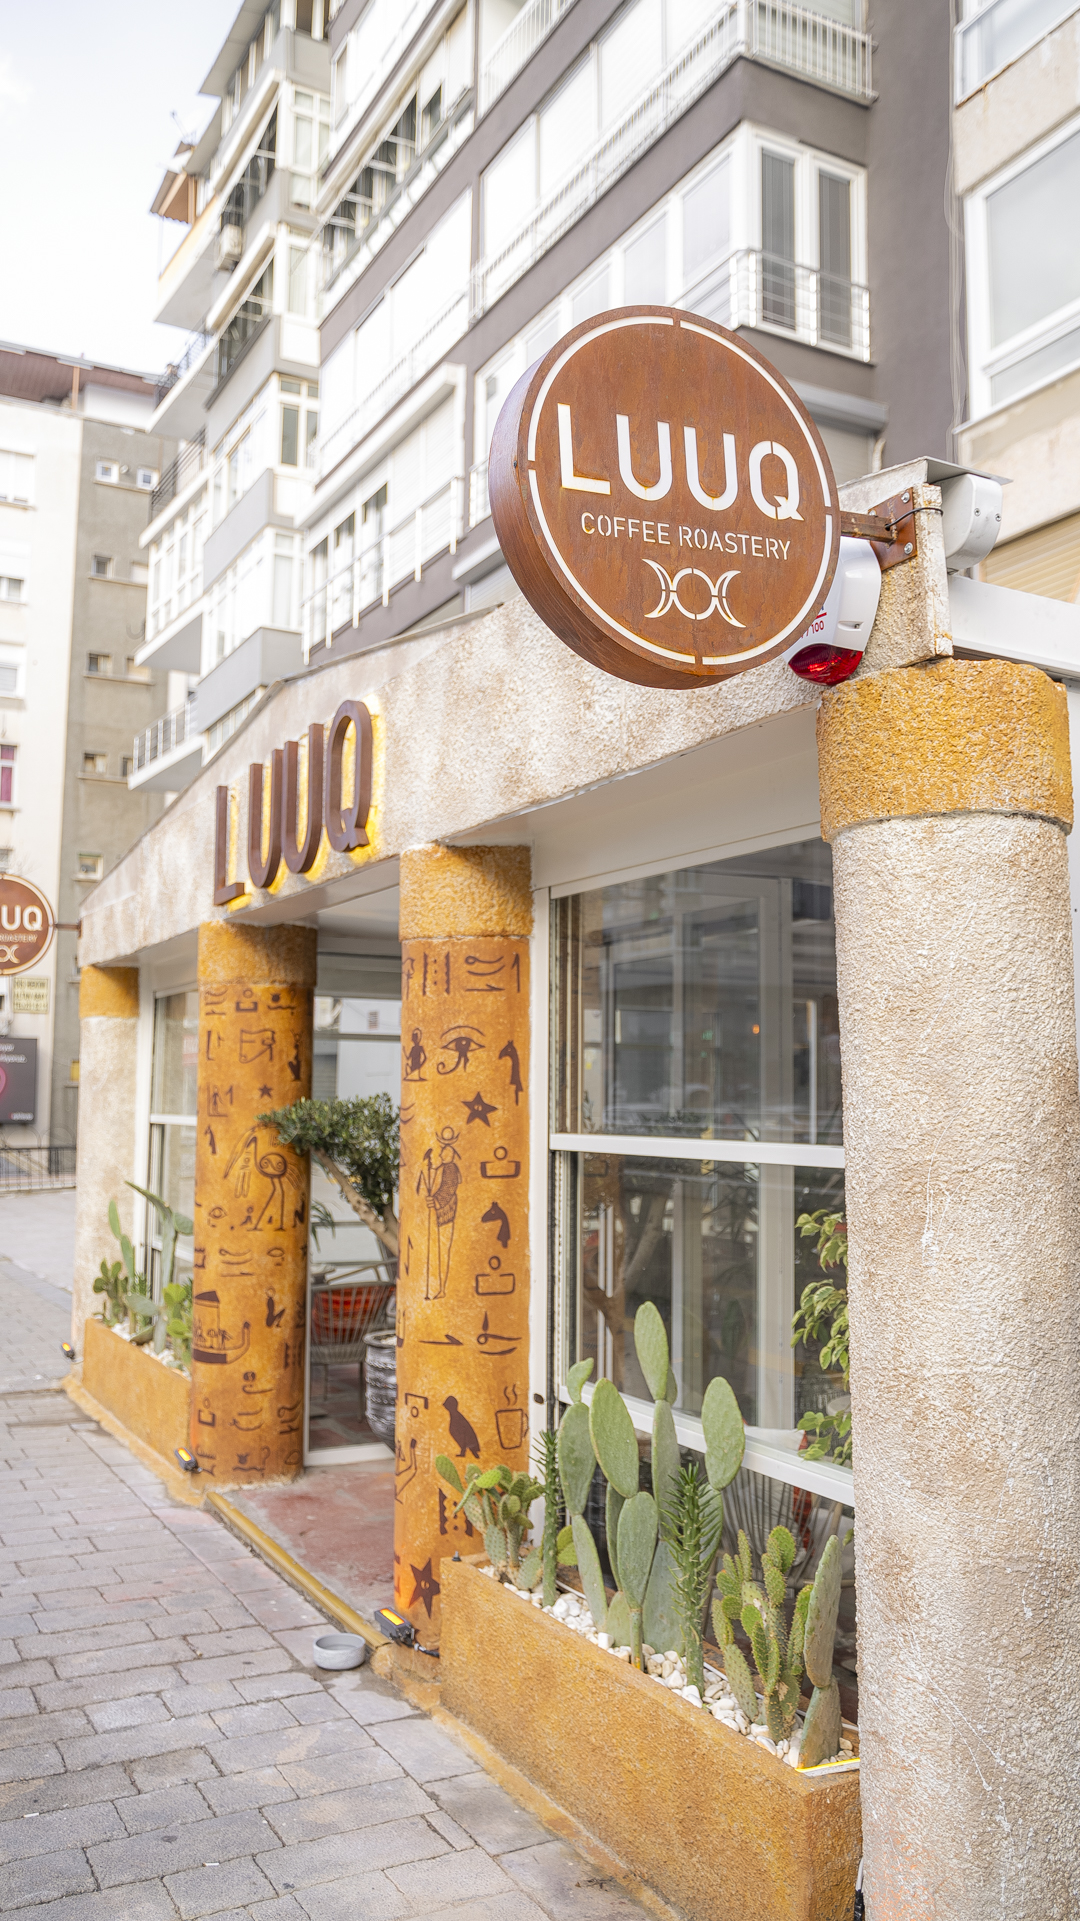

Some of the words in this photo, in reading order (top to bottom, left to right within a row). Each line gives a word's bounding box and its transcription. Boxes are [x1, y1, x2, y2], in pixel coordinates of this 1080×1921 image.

[557, 402, 805, 521] LUUQ
[581, 512, 670, 545] COFFEE
[678, 525, 791, 561] ROASTERY
[214, 700, 373, 906] LUUQ
